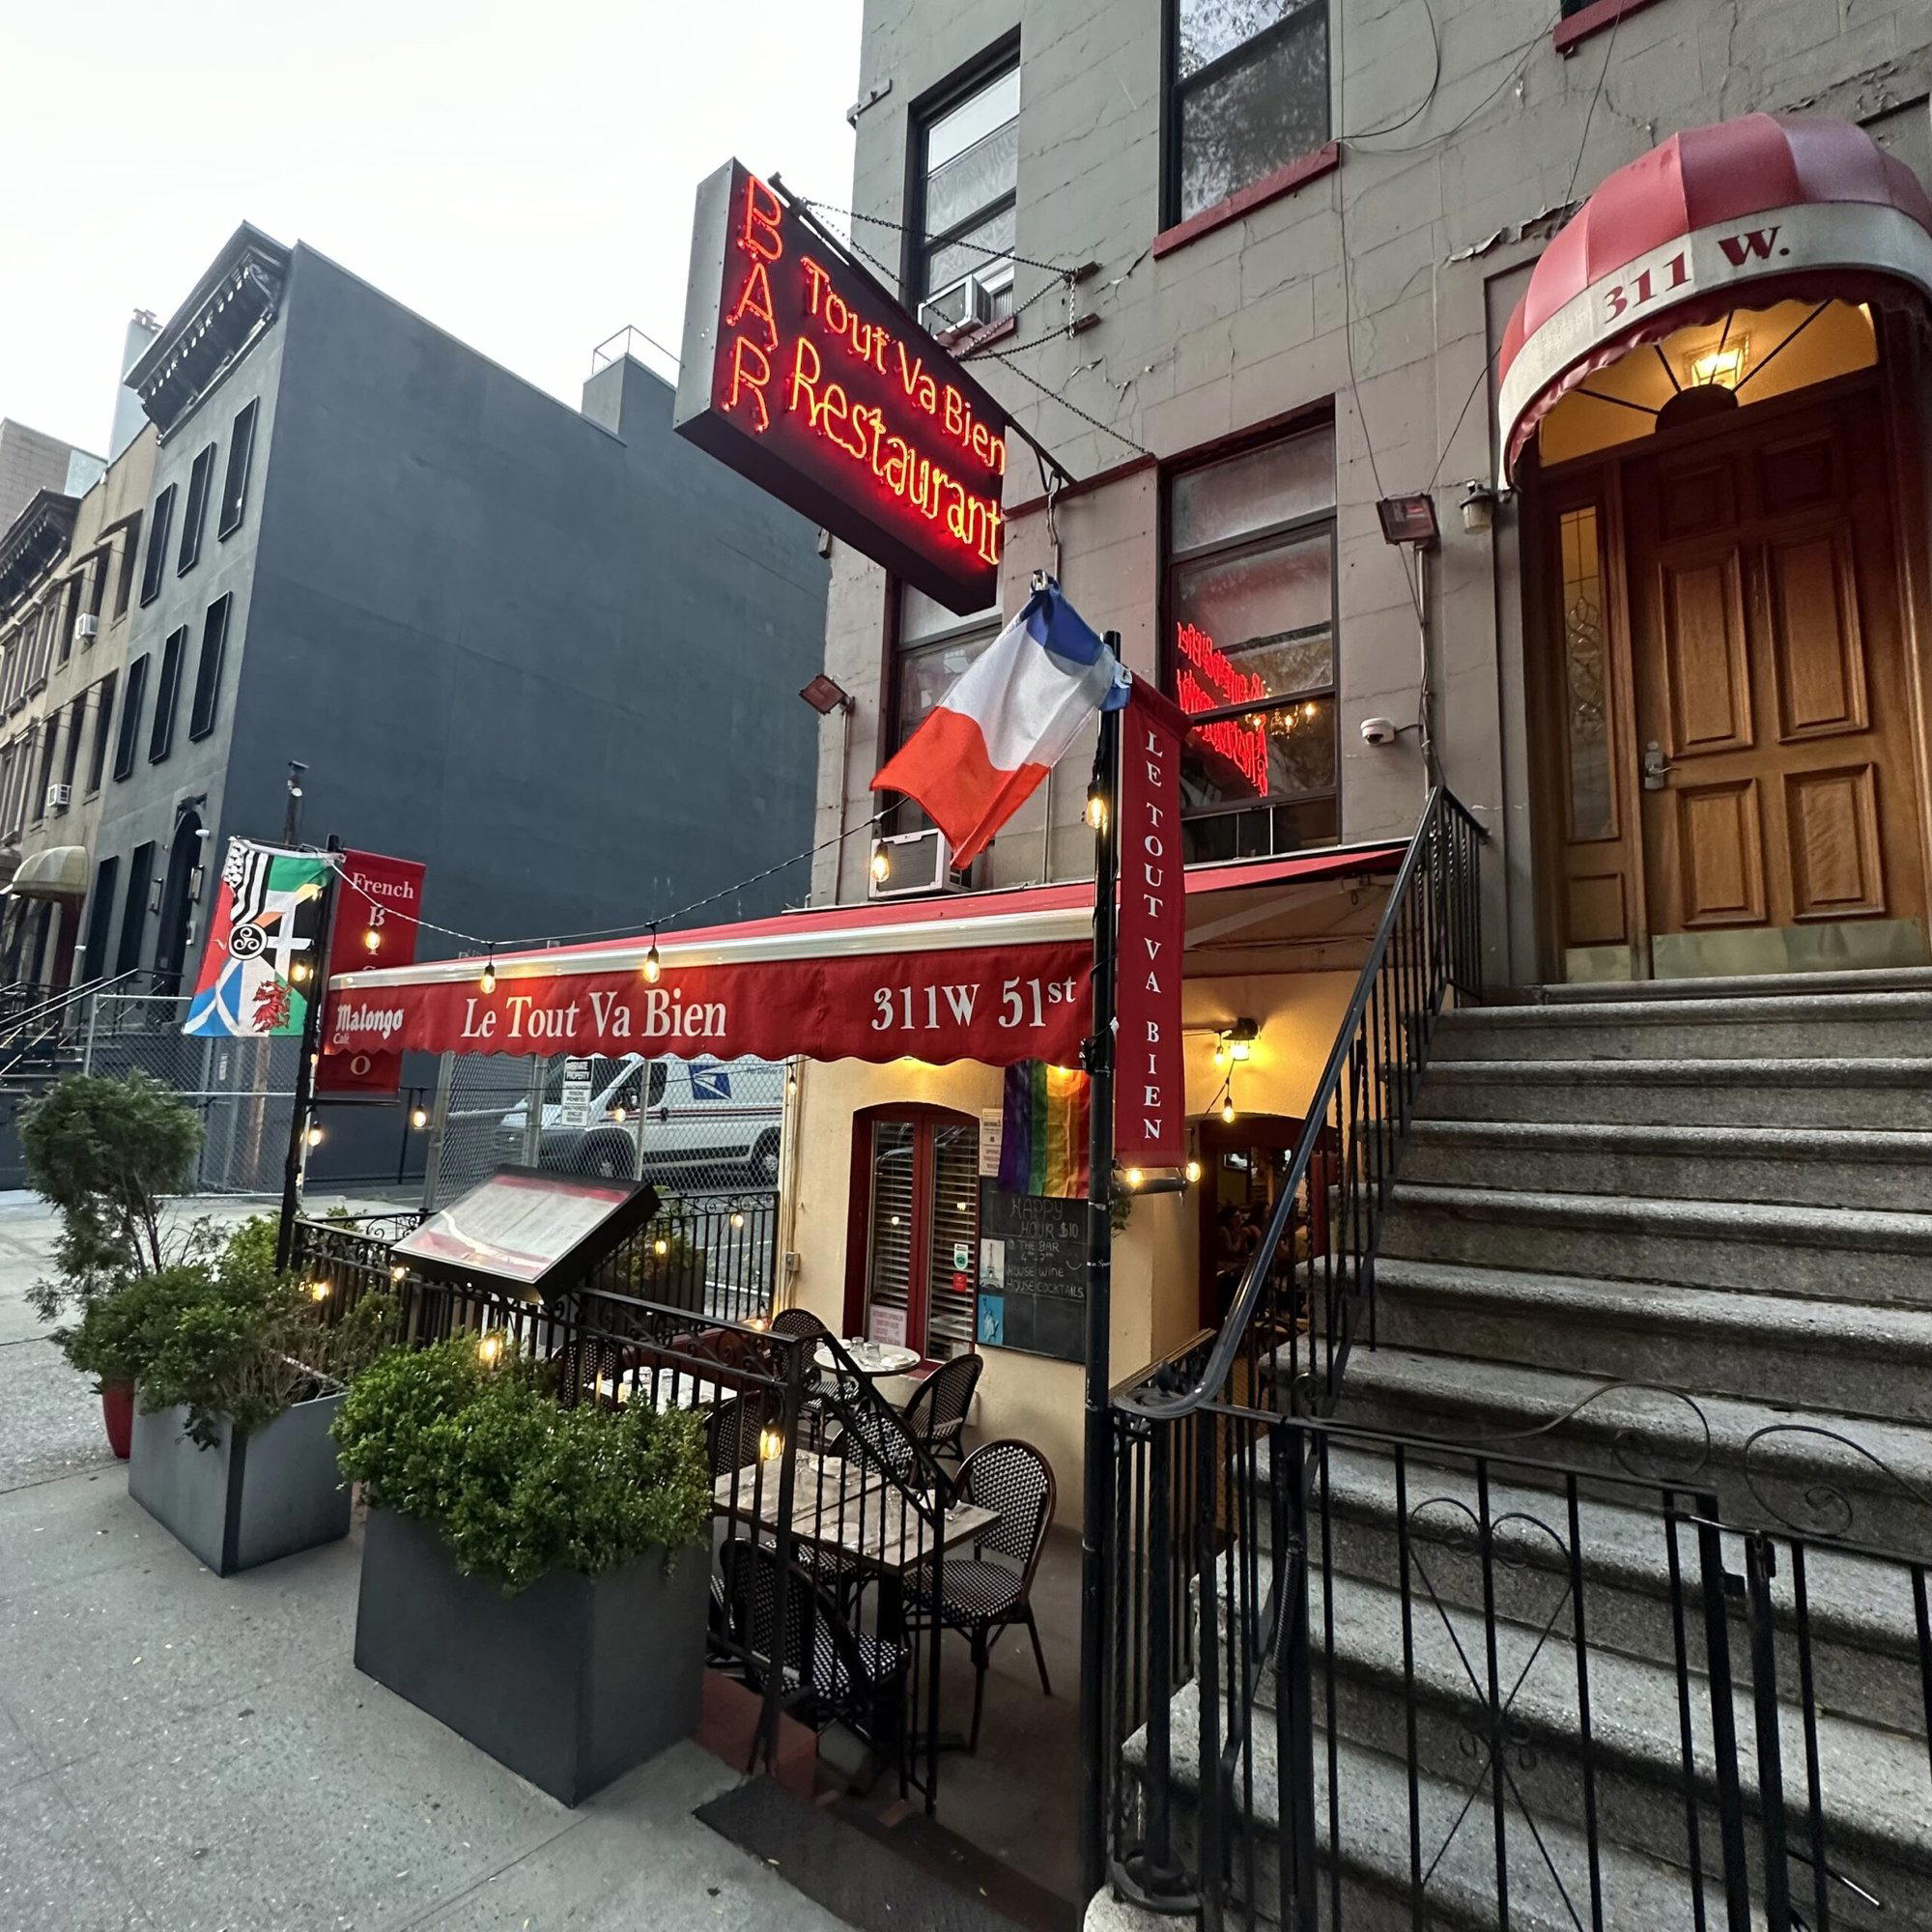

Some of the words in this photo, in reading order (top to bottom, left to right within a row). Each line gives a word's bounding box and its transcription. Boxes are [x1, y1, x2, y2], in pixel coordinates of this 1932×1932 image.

[1604, 251, 1691, 325] 311
[1718, 225, 1791, 267] W.
[722, 175, 783, 433] BAR
[800, 255, 888, 376] Tout
[897, 340, 937, 415] Va
[944, 384, 1006, 476] Bien
[788, 336, 1003, 565] Restaurant
[1145, 730, 1163, 787] LE
[351, 872, 414, 899] French
[1143, 802, 1164, 918] TOUT
[1143, 937, 1163, 994] VA
[335, 1003, 405, 1040] Malongo
[460, 998, 497, 1038] Le
[505, 995, 580, 1038] Tout
[588, 990, 631, 1037] Va
[641, 987, 726, 1037] Bien
[998, 976, 1077, 1029] 51st
[1143, 1020, 1163, 1141] BIEN
[1010, 1197, 1064, 1221] HAPPY
[1020, 1220, 1055, 1238] HOUR
[1038, 1239, 1061, 1253] BAR
